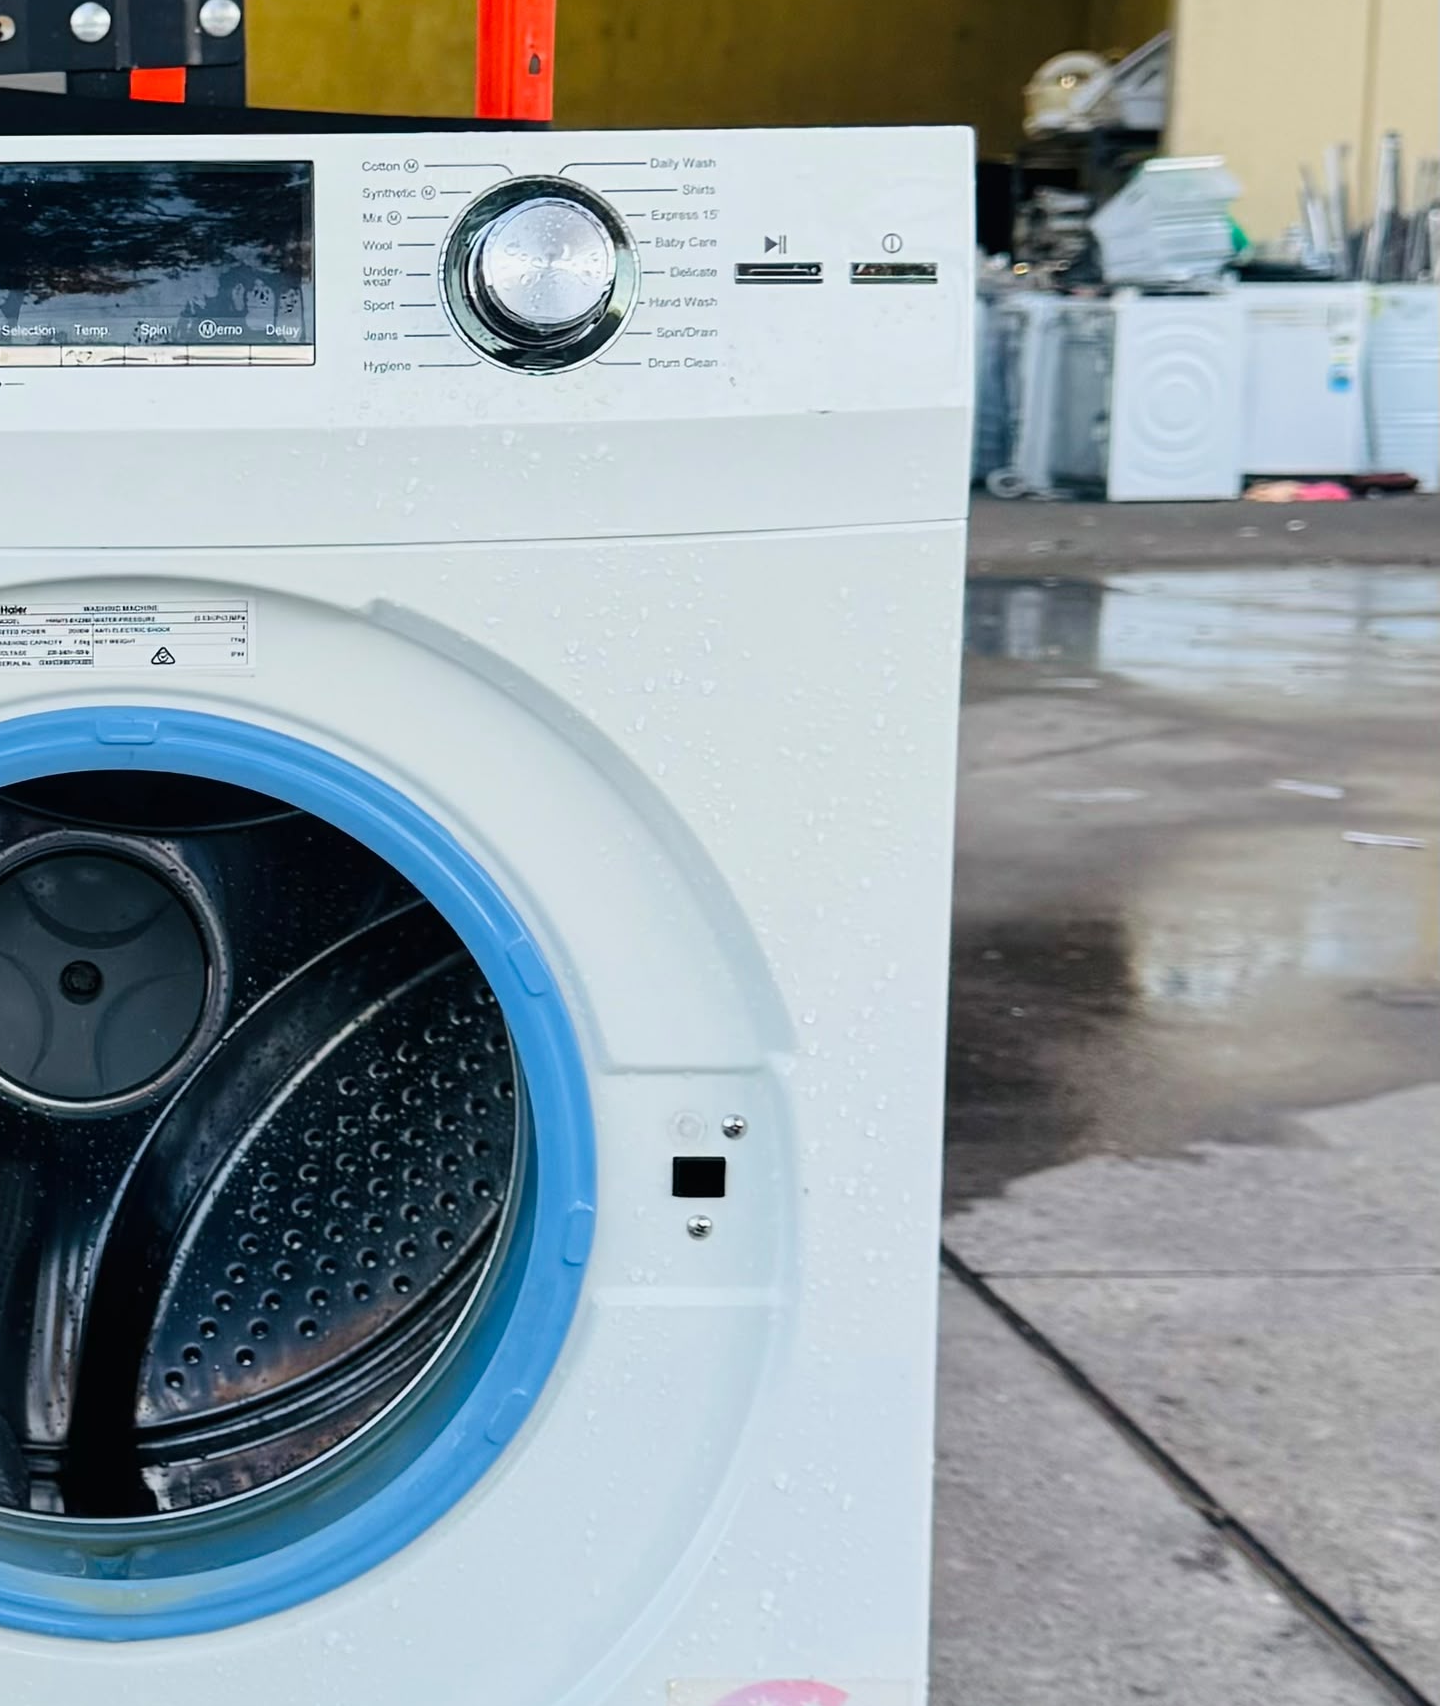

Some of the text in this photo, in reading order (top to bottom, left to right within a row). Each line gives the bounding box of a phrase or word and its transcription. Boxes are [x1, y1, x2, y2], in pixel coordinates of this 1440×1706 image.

[361, 161, 401, 172] Cotton
[650, 157, 717, 170] Daily Wash
[362, 188, 417, 200] Synthetic
[682, 184, 716, 195] Shirts
[362, 213, 383, 223] Mix
[651, 209, 699, 221] Express
[362, 240, 393, 251] Wool
[655, 237, 717, 249] Baby Care
[670, 266, 718, 278] Delicate
[362, 278, 392, 287] wear
[363, 300, 395, 312] Sport
[648, 296, 718, 308] Hand Wash
[1, 325, 56, 336] Selection
[140, 324, 168, 337] Spin
[265, 324, 301, 337] Delay
[363, 330, 399, 341] Jeans
[656, 327, 718, 338] Spin/Drain
[363, 361, 412, 374] Hygiene
[648, 357, 718, 368] Drum Clean
[0, 605, 27, 615] Haier
